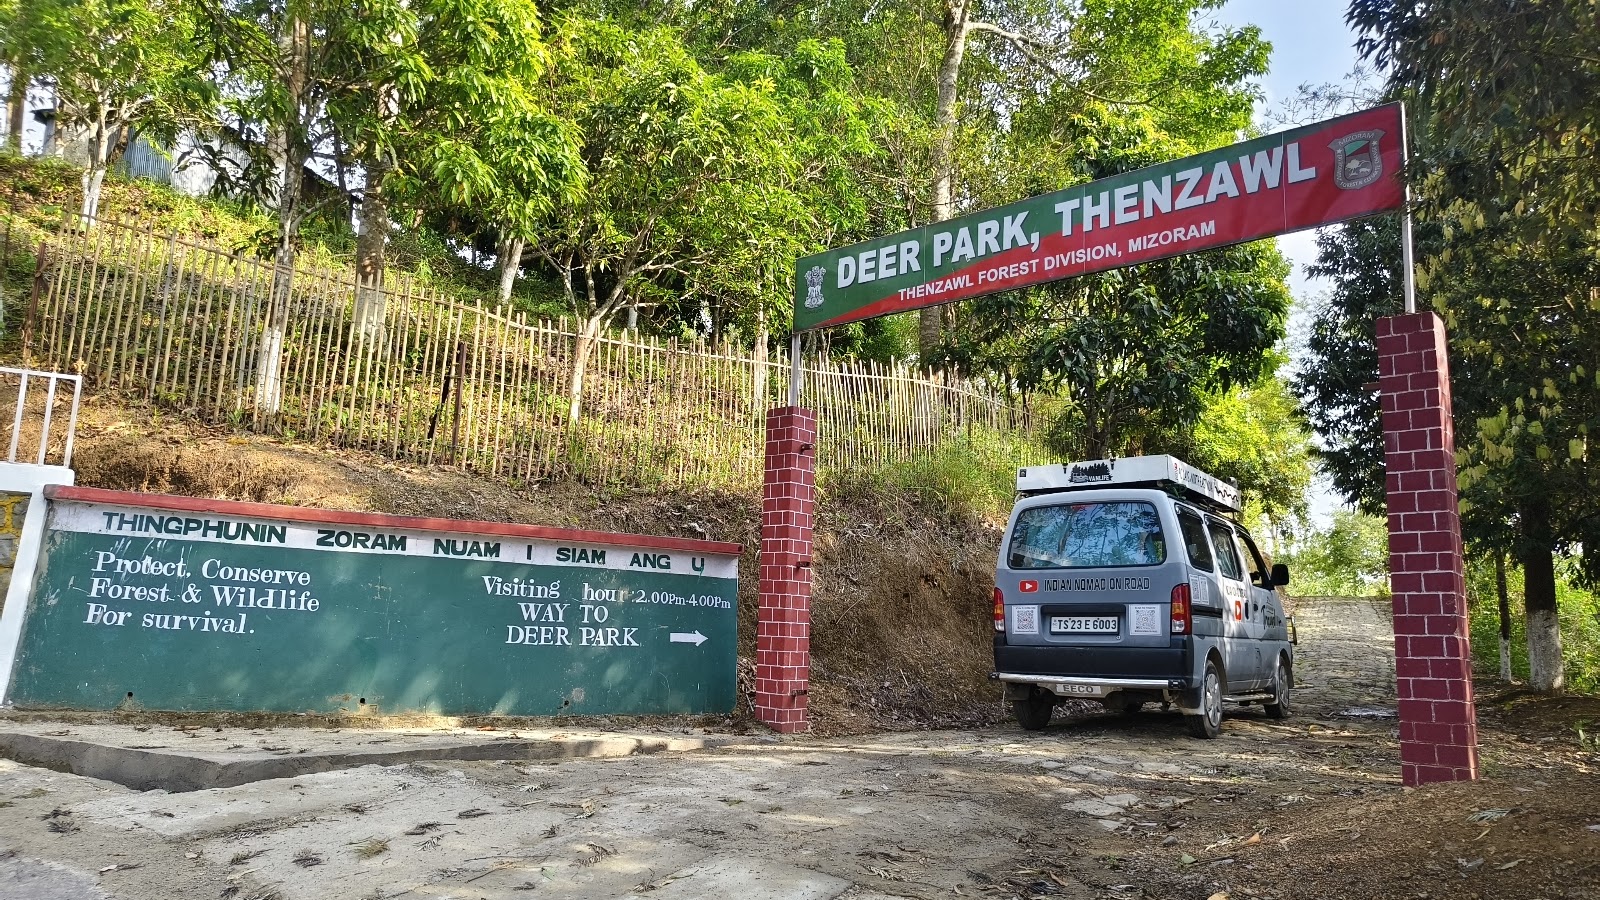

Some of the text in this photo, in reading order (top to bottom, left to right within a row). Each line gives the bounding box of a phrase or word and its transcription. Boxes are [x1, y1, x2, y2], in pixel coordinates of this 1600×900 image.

[1338, 132, 1375, 146] MIZORAM
[837, 239, 922, 289] DEER
[933, 210, 1040, 268] PARK,
[1054, 142, 1317, 238] THENZAWL
[898, 219, 1216, 301] THENZAWL FOREST DIVISION, MIZORAM
[102, 510, 287, 544] THINGPHUNIN
[316, 529, 407, 552] ZORAM
[433, 538, 501, 558] NUAM
[526, 544, 532, 561] I
[556, 547, 606, 565] SIAM
[629, 552, 671, 570] ANG
[202, 558, 311, 586] Conserve
[1044, 577, 1150, 592] INDIAN NOMAD ON ROAD
[87, 577, 320, 612] Forest & Wildlife
[481, 575, 561, 600] Visiting
[83, 602, 255, 634] For survival.
[518, 602, 609, 624] WAY TO
[1092, 619, 1117, 630] 6003
[505, 625, 640, 647] DEER PARK
[1062, 684, 1094, 694] EECO
